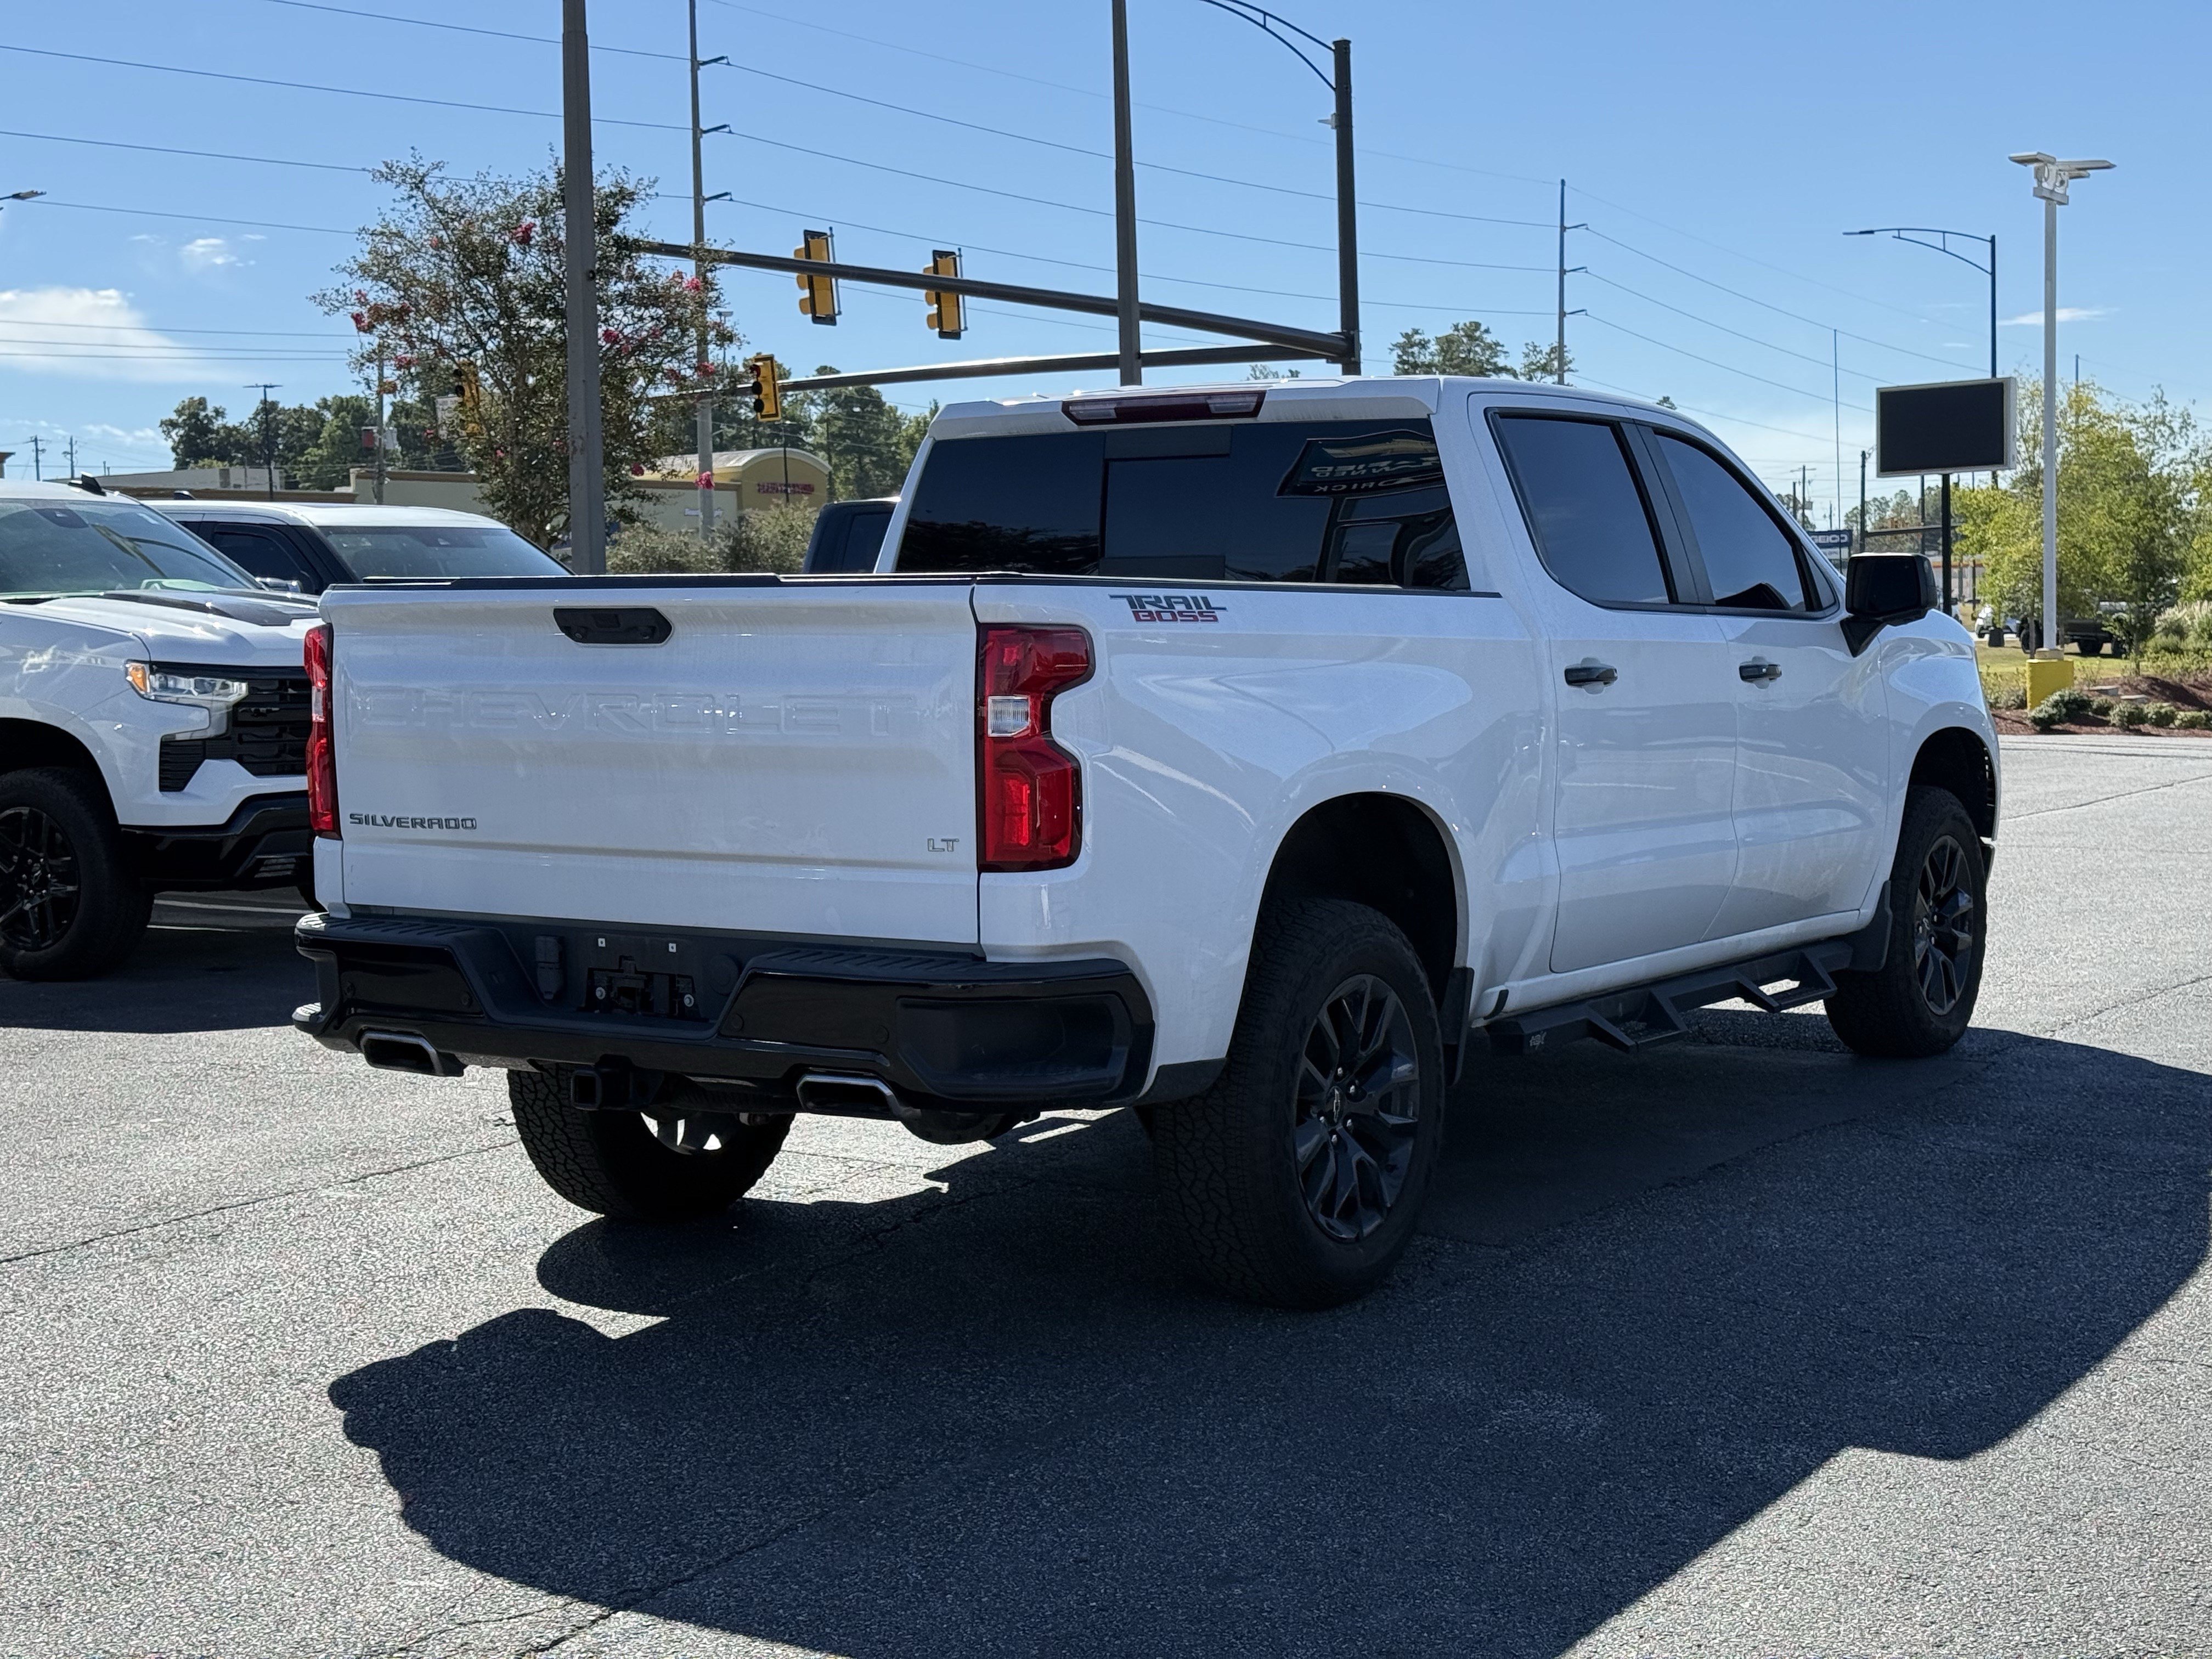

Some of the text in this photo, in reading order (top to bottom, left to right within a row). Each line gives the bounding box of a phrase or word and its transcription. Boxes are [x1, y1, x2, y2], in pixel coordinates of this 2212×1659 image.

[1810, 534, 1848, 543] GEICO
[1108, 594, 1227, 611] TRAIL
[1132, 610, 1218, 623] BOSS
[360, 688, 916, 736] CHEVROLET
[349, 813, 477, 830] SILVERADO
[927, 838, 960, 852] LT
